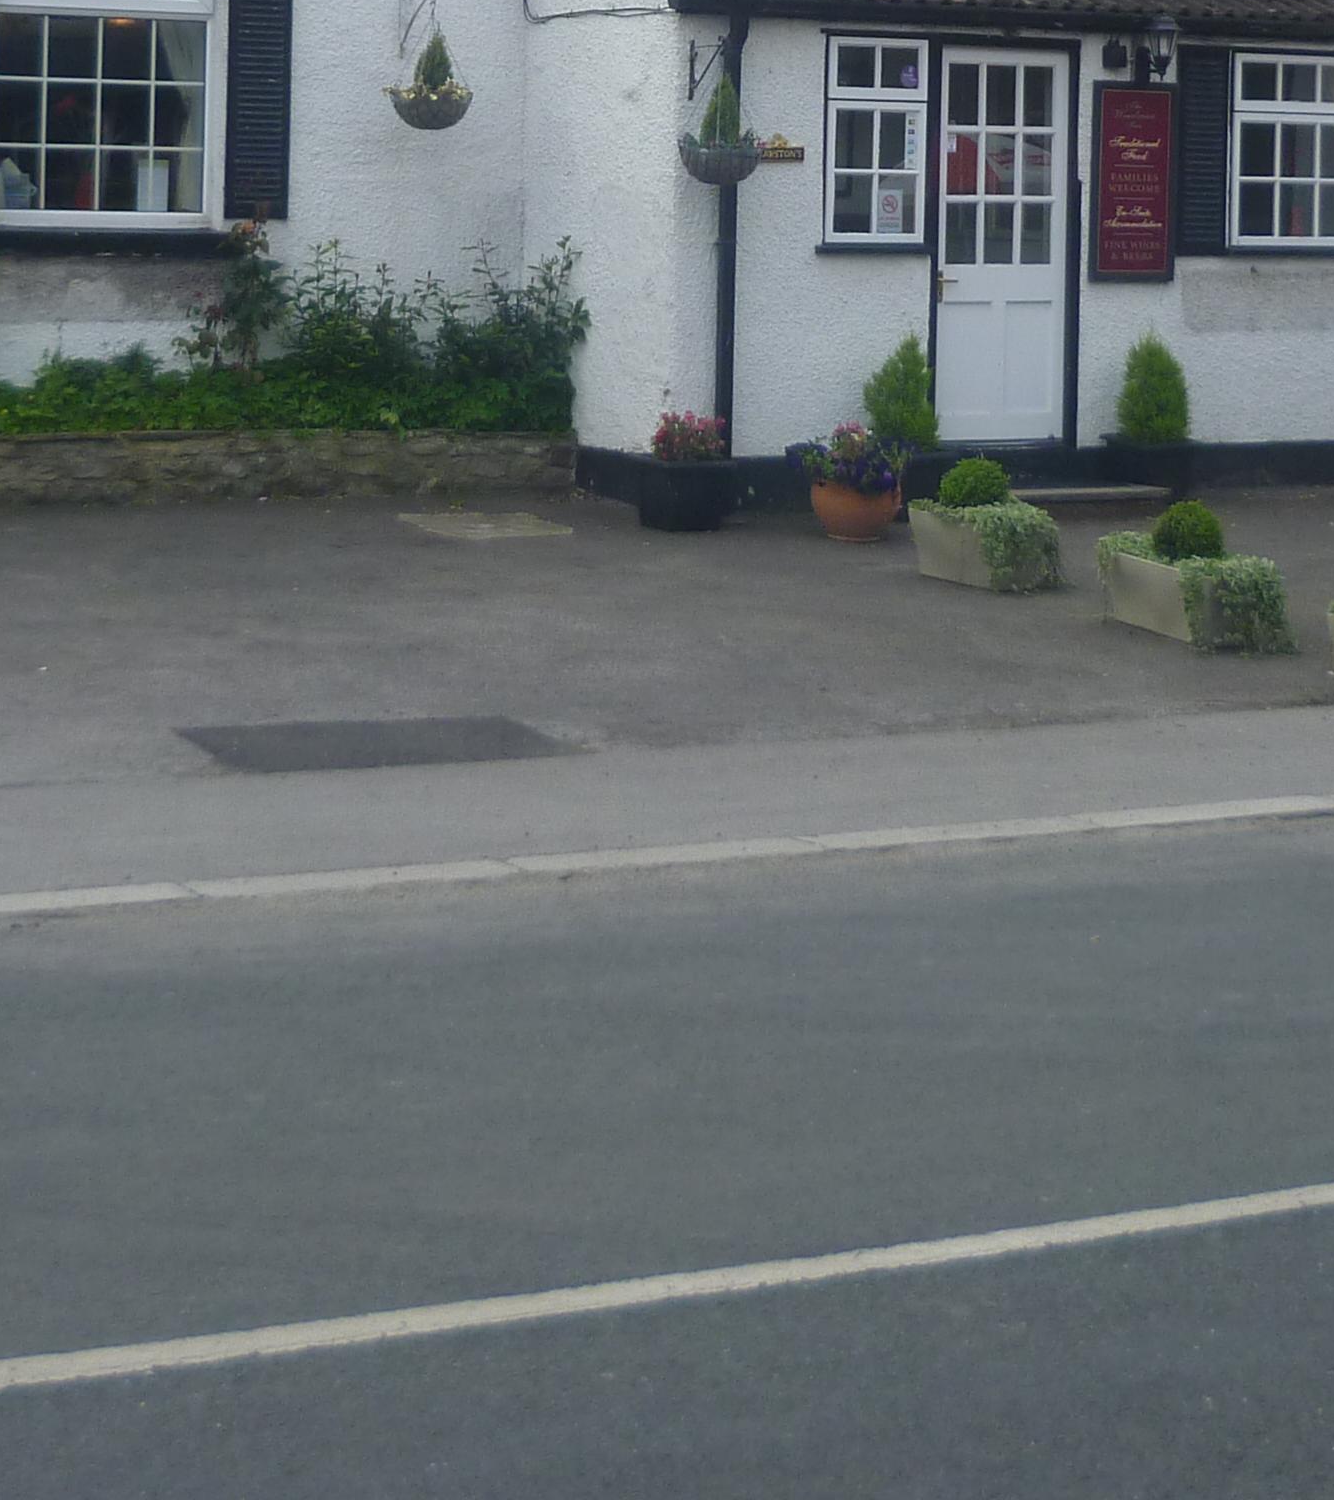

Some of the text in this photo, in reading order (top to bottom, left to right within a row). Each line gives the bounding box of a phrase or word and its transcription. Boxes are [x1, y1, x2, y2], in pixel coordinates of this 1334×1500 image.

[1108, 134, 1162, 149] Traditional
[762, 148, 803, 160] ARSTON'S
[1120, 148, 1149, 161] Food
[1110, 172, 1160, 182] FAMILIES
[1108, 183, 1161, 193] WELCOME
